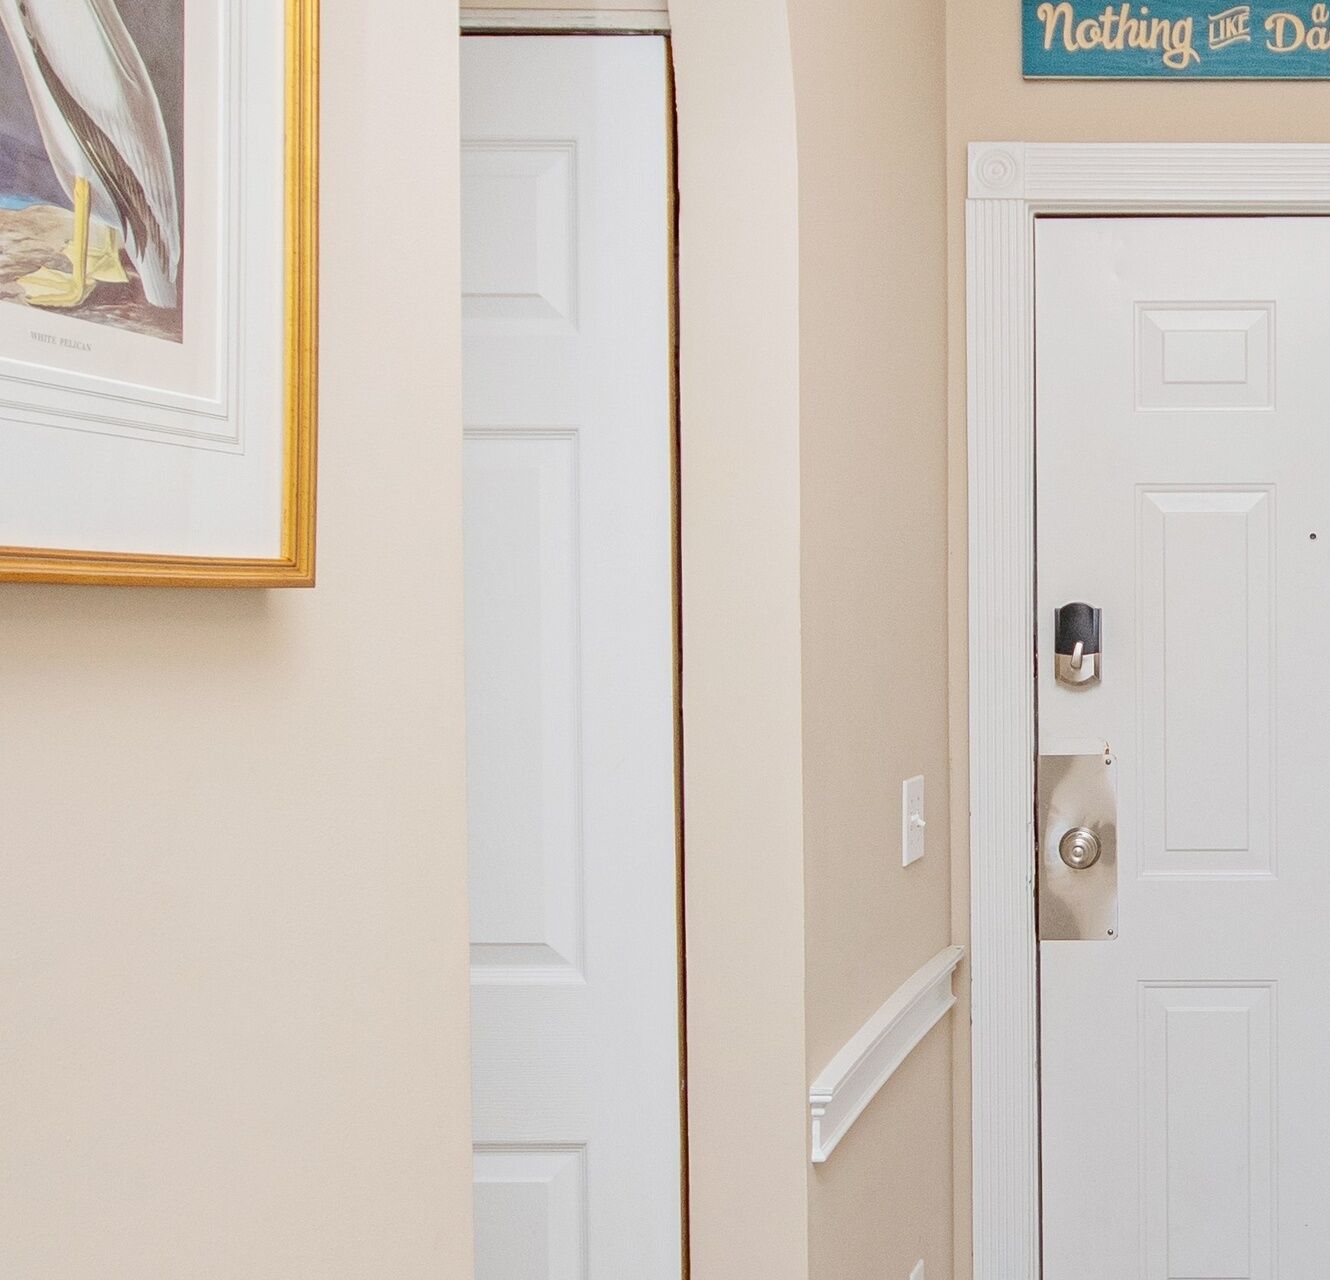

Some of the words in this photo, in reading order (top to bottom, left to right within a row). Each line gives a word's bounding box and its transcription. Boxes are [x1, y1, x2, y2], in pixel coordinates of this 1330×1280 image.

[1037, 1, 1200, 68] Nothing
[1208, 13, 1250, 43] LIKE
[1311, 3, 1330, 23] a
[30, 330, 57, 344] WHITE
[59, 337, 93, 352] PELICAN
